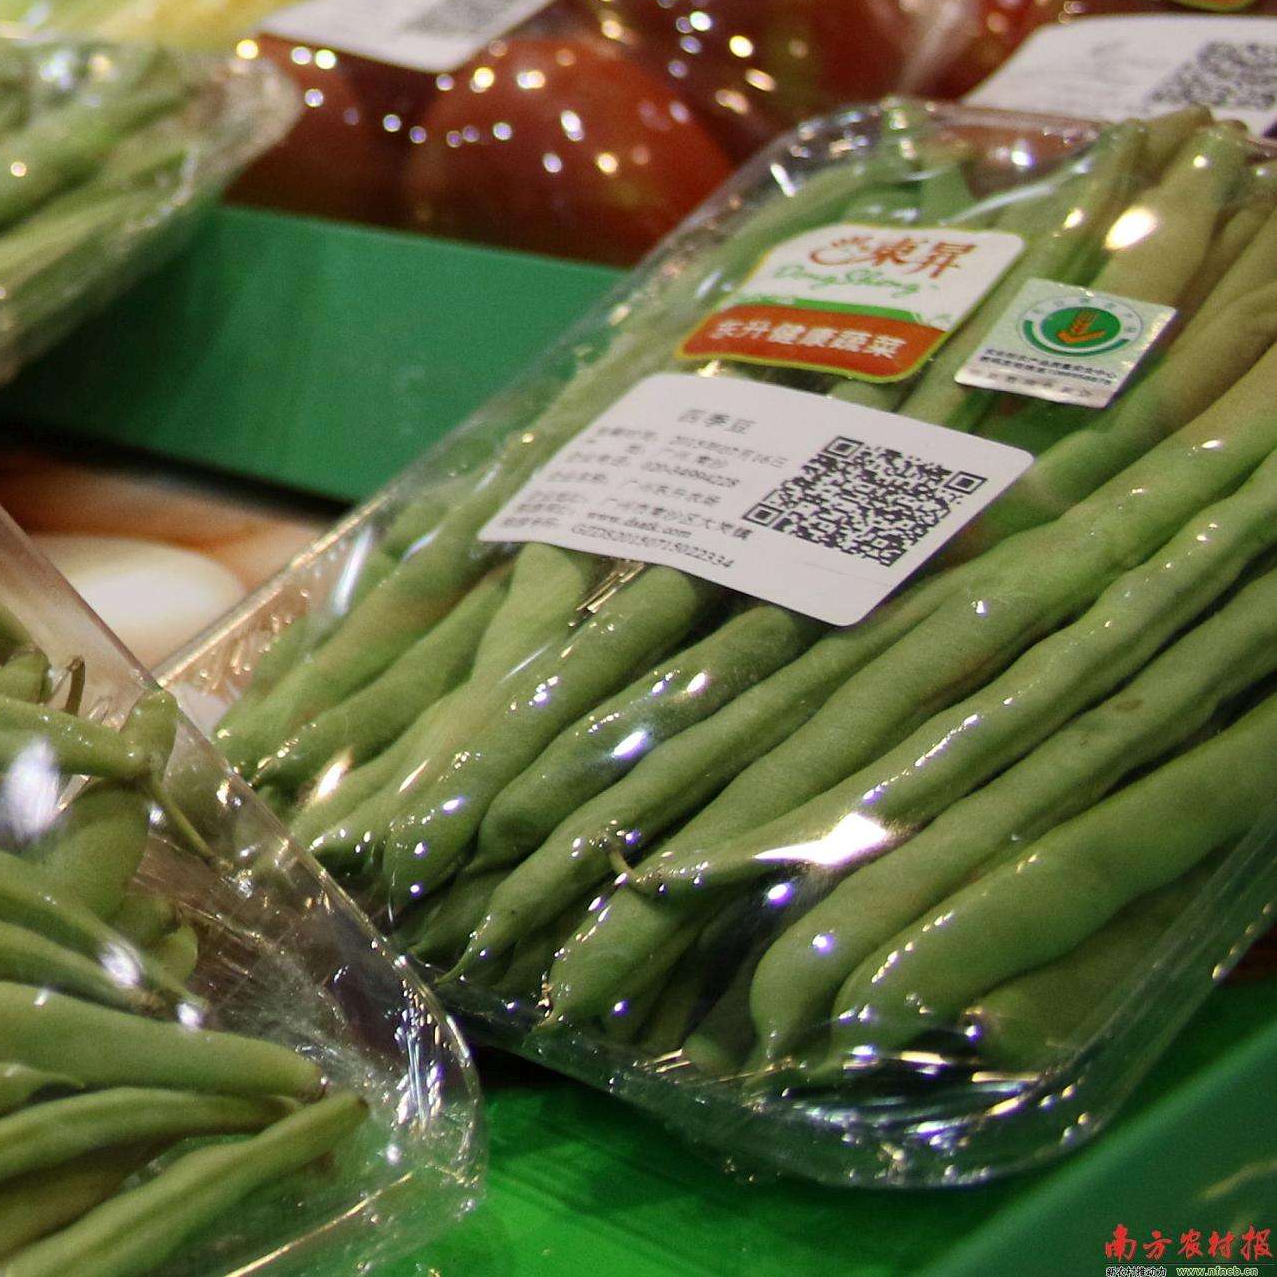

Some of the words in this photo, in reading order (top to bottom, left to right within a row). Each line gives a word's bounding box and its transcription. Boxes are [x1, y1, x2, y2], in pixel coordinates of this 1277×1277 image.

[710, 318, 906, 359] 东升健康蔬菜
